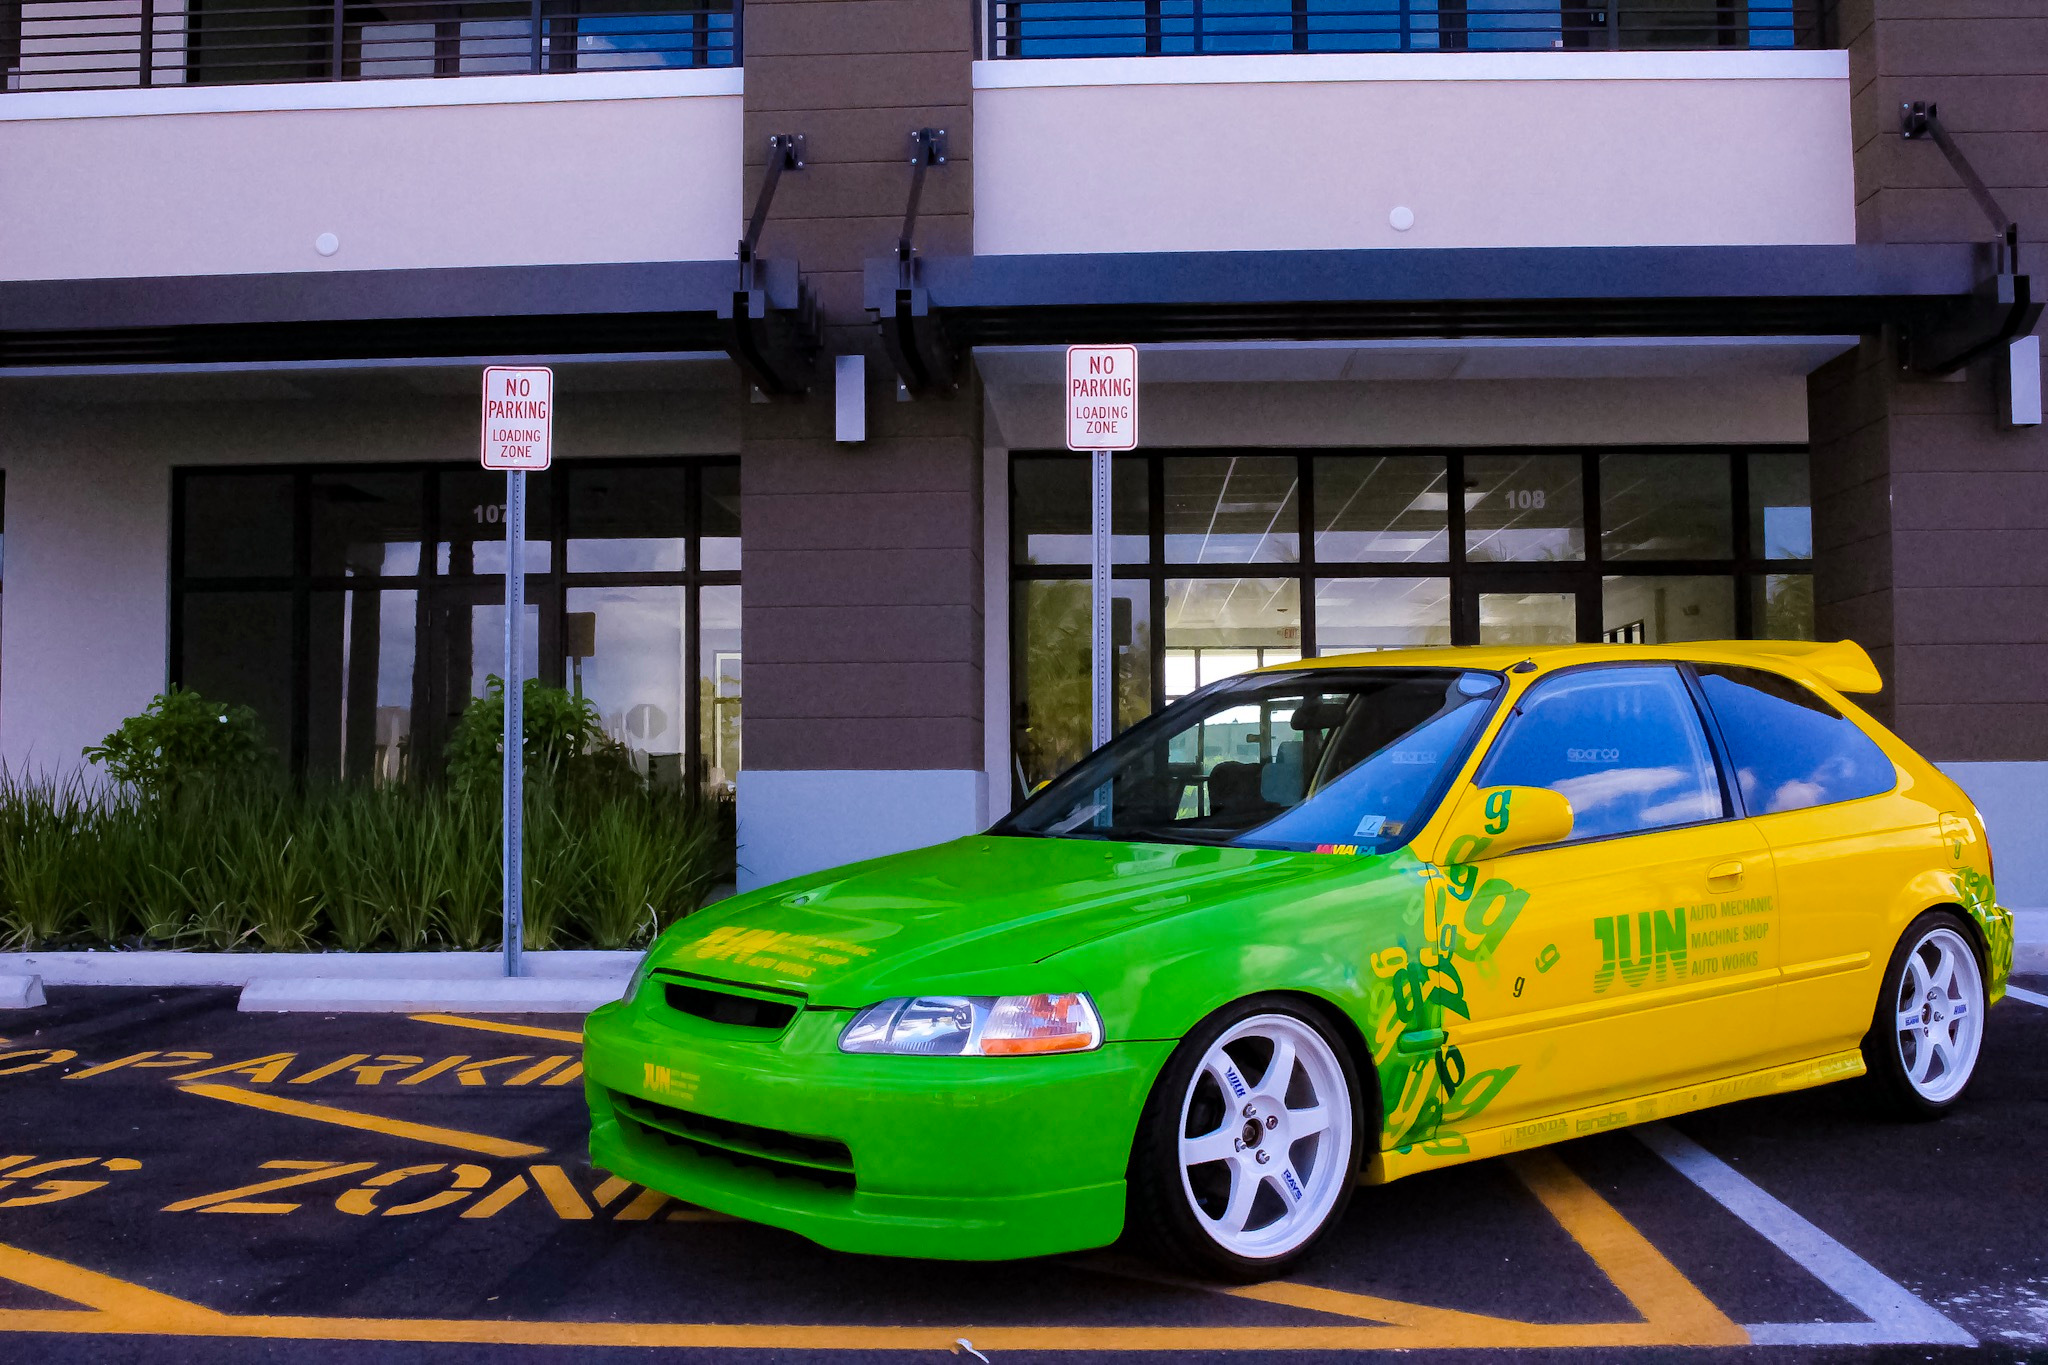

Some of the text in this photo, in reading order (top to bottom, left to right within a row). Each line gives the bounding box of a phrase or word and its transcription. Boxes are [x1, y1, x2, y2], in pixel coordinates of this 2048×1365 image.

[1089, 356, 1114, 374] NO
[506, 378, 530, 397] NO
[1072, 378, 1131, 397] PARKING
[488, 401, 546, 419] PARKING
[1076, 406, 1128, 419] LOADING
[492, 429, 541, 442] LOADING
[1086, 421, 1118, 434] ZONE
[500, 445, 532, 458] ZONE
[1505, 490, 1545, 509] 108
[1567, 747, 1620, 760] sparco
[1690, 895, 1774, 921] AUTO MECHANIC
[1691, 922, 1769, 949] MACHINE SHOP
[1691, 951, 1759, 976] AUTO WORKS
[1515, 1117, 1568, 1139] HONDA
[1576, 1111, 1629, 1132] tanabe
